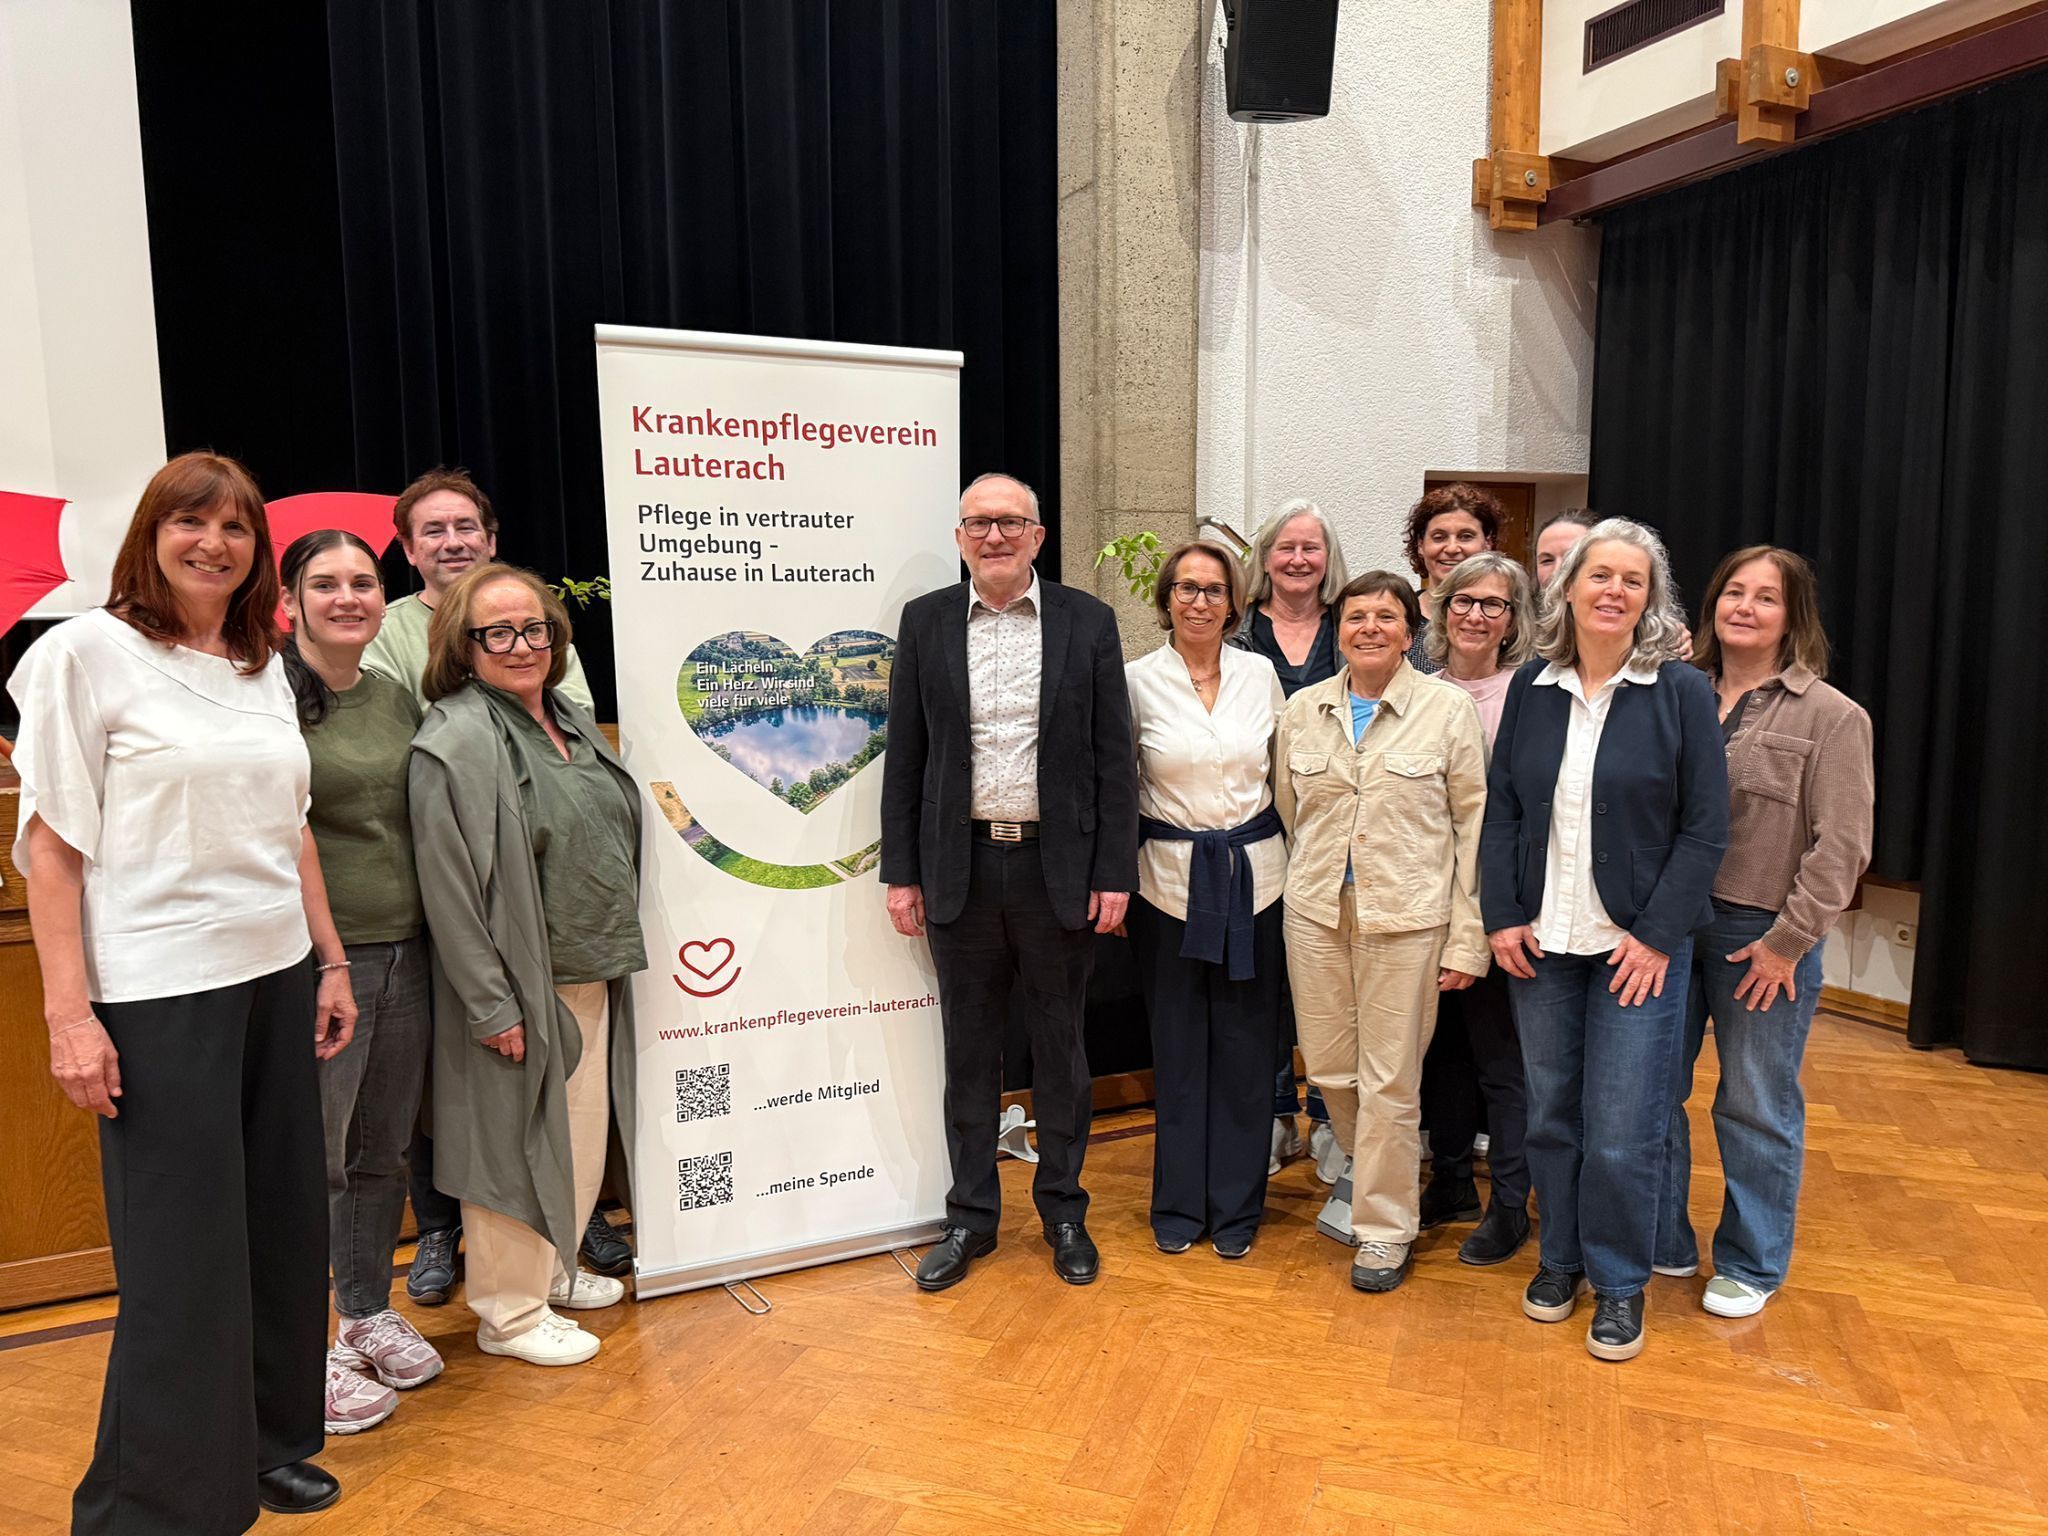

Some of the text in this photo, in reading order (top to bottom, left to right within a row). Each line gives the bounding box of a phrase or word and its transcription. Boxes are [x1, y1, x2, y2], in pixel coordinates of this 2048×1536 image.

[632, 405, 938, 449] Krankenpflegeverein
[634, 448, 785, 481] Lauterach
[638, 504, 855, 530] Pflege in vertrauter
[639, 533, 762, 559] Umgebung
[640, 561, 875, 582] Zuhause in Lauterach
[696, 660, 777, 674] Ein Lächeln.
[697, 676, 815, 692] Ein Herz. Wir sind
[697, 693, 788, 708] viele für viele
[658, 993, 940, 1041] www.krankenpflegeverein-lauterach.
[818, 1079, 880, 1101] Mitglied
[819, 1165, 875, 1188] Spende
